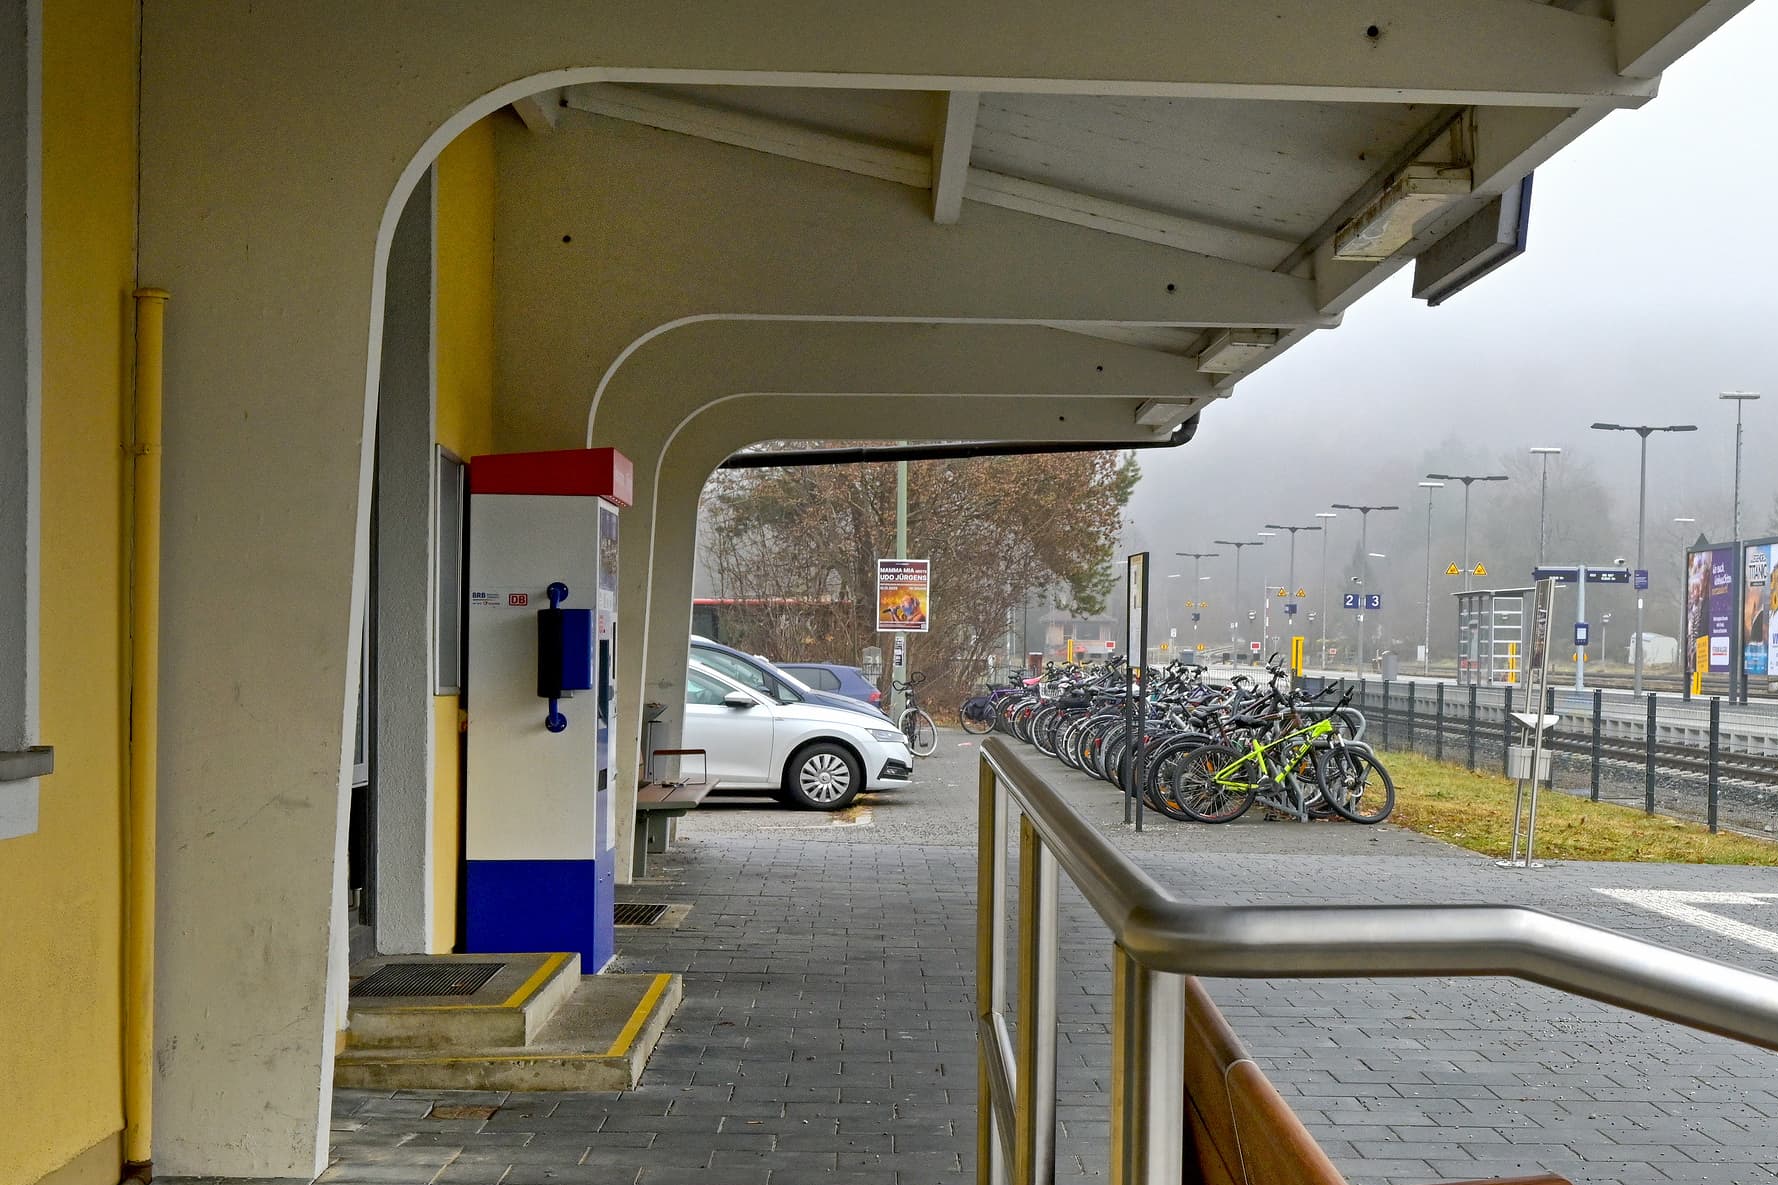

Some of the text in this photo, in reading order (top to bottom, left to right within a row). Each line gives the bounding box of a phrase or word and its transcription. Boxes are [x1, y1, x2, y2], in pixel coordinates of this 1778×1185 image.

[895, 572, 927, 581] JÜRGENS
[510, 594, 527, 605] DB
[1345, 595, 1353, 606] 2
[1371, 595, 1379, 607] 3
